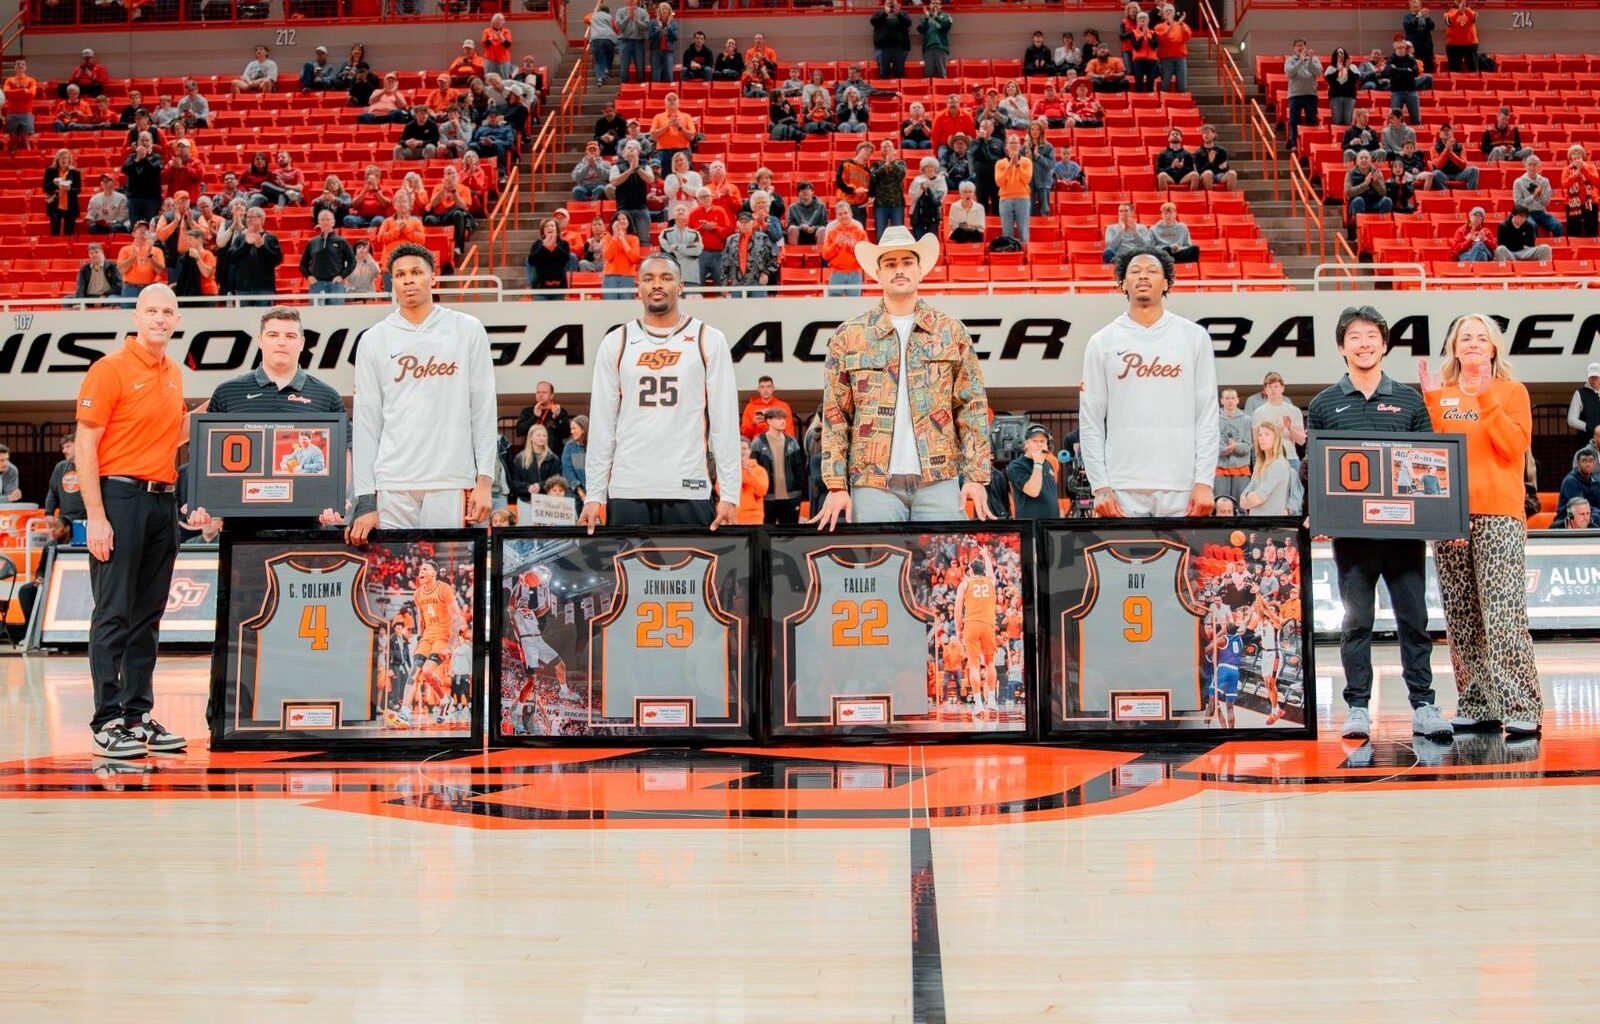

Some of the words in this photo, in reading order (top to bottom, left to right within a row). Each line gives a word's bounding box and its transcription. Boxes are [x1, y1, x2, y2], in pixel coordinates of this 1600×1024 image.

[1512, 11, 1534, 28] 214
[276, 28, 297, 46] 212
[14, 314, 34, 331] 107
[394, 354, 459, 383] Pokes
[636, 349, 683, 371] OSU
[1117, 353, 1183, 380] Pokes
[639, 376, 679, 408] 25
[535, 509, 573, 520] SENIORS!
[289, 583, 298, 599] C.
[302, 581, 342, 599] COLEMAN
[644, 579, 687, 595] JENNINGS
[844, 577, 876, 593] FALLAH
[1128, 573, 1146, 589] ROY
[973, 584, 989, 598] 22
[298, 604, 330, 651] 4
[636, 601, 694, 648] 25
[832, 598, 889, 647] 22
[1123, 595, 1153, 643] 9
